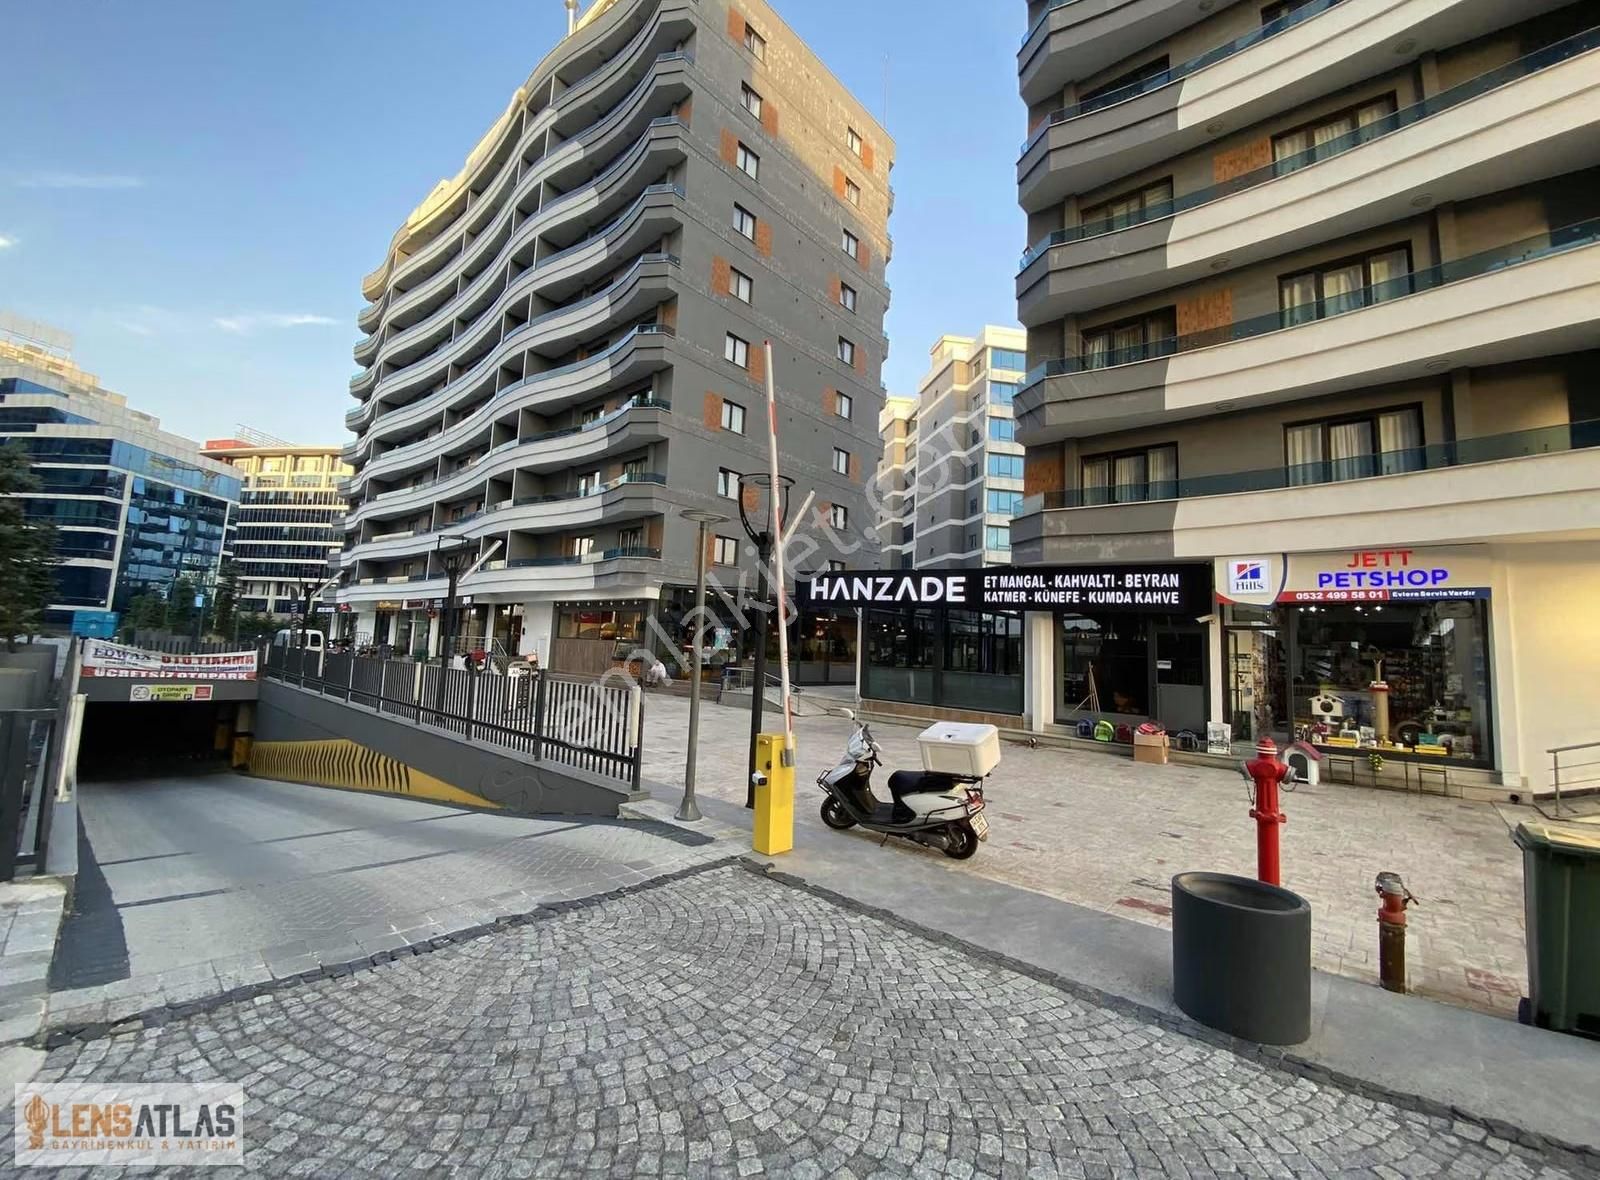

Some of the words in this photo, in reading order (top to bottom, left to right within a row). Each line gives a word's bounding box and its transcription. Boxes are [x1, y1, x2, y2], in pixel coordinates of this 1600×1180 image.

[1347, 551, 1413, 568] JETT
[984, 575, 998, 588] ET
[1000, 575, 1046, 588] MANGAL
[1054, 574, 1115, 588] KAHVALTI
[1125, 573, 1179, 588] BEYRAN
[1318, 569, 1449, 588] PETSHOP
[810, 576, 966, 602] HANZADE
[984, 591, 1027, 603] KATMER
[1034, 589, 1080, 603] KÜNEFE
[1088, 591, 1132, 604] KUMDA
[1135, 591, 1179, 604] KAHVE
[1296, 592, 1324, 600] 0532
[1325, 591, 1348, 600] 499
[1350, 590, 1367, 599] 58
[1368, 590, 1384, 599] 01
[177, 671, 247, 680] OTOPARK
